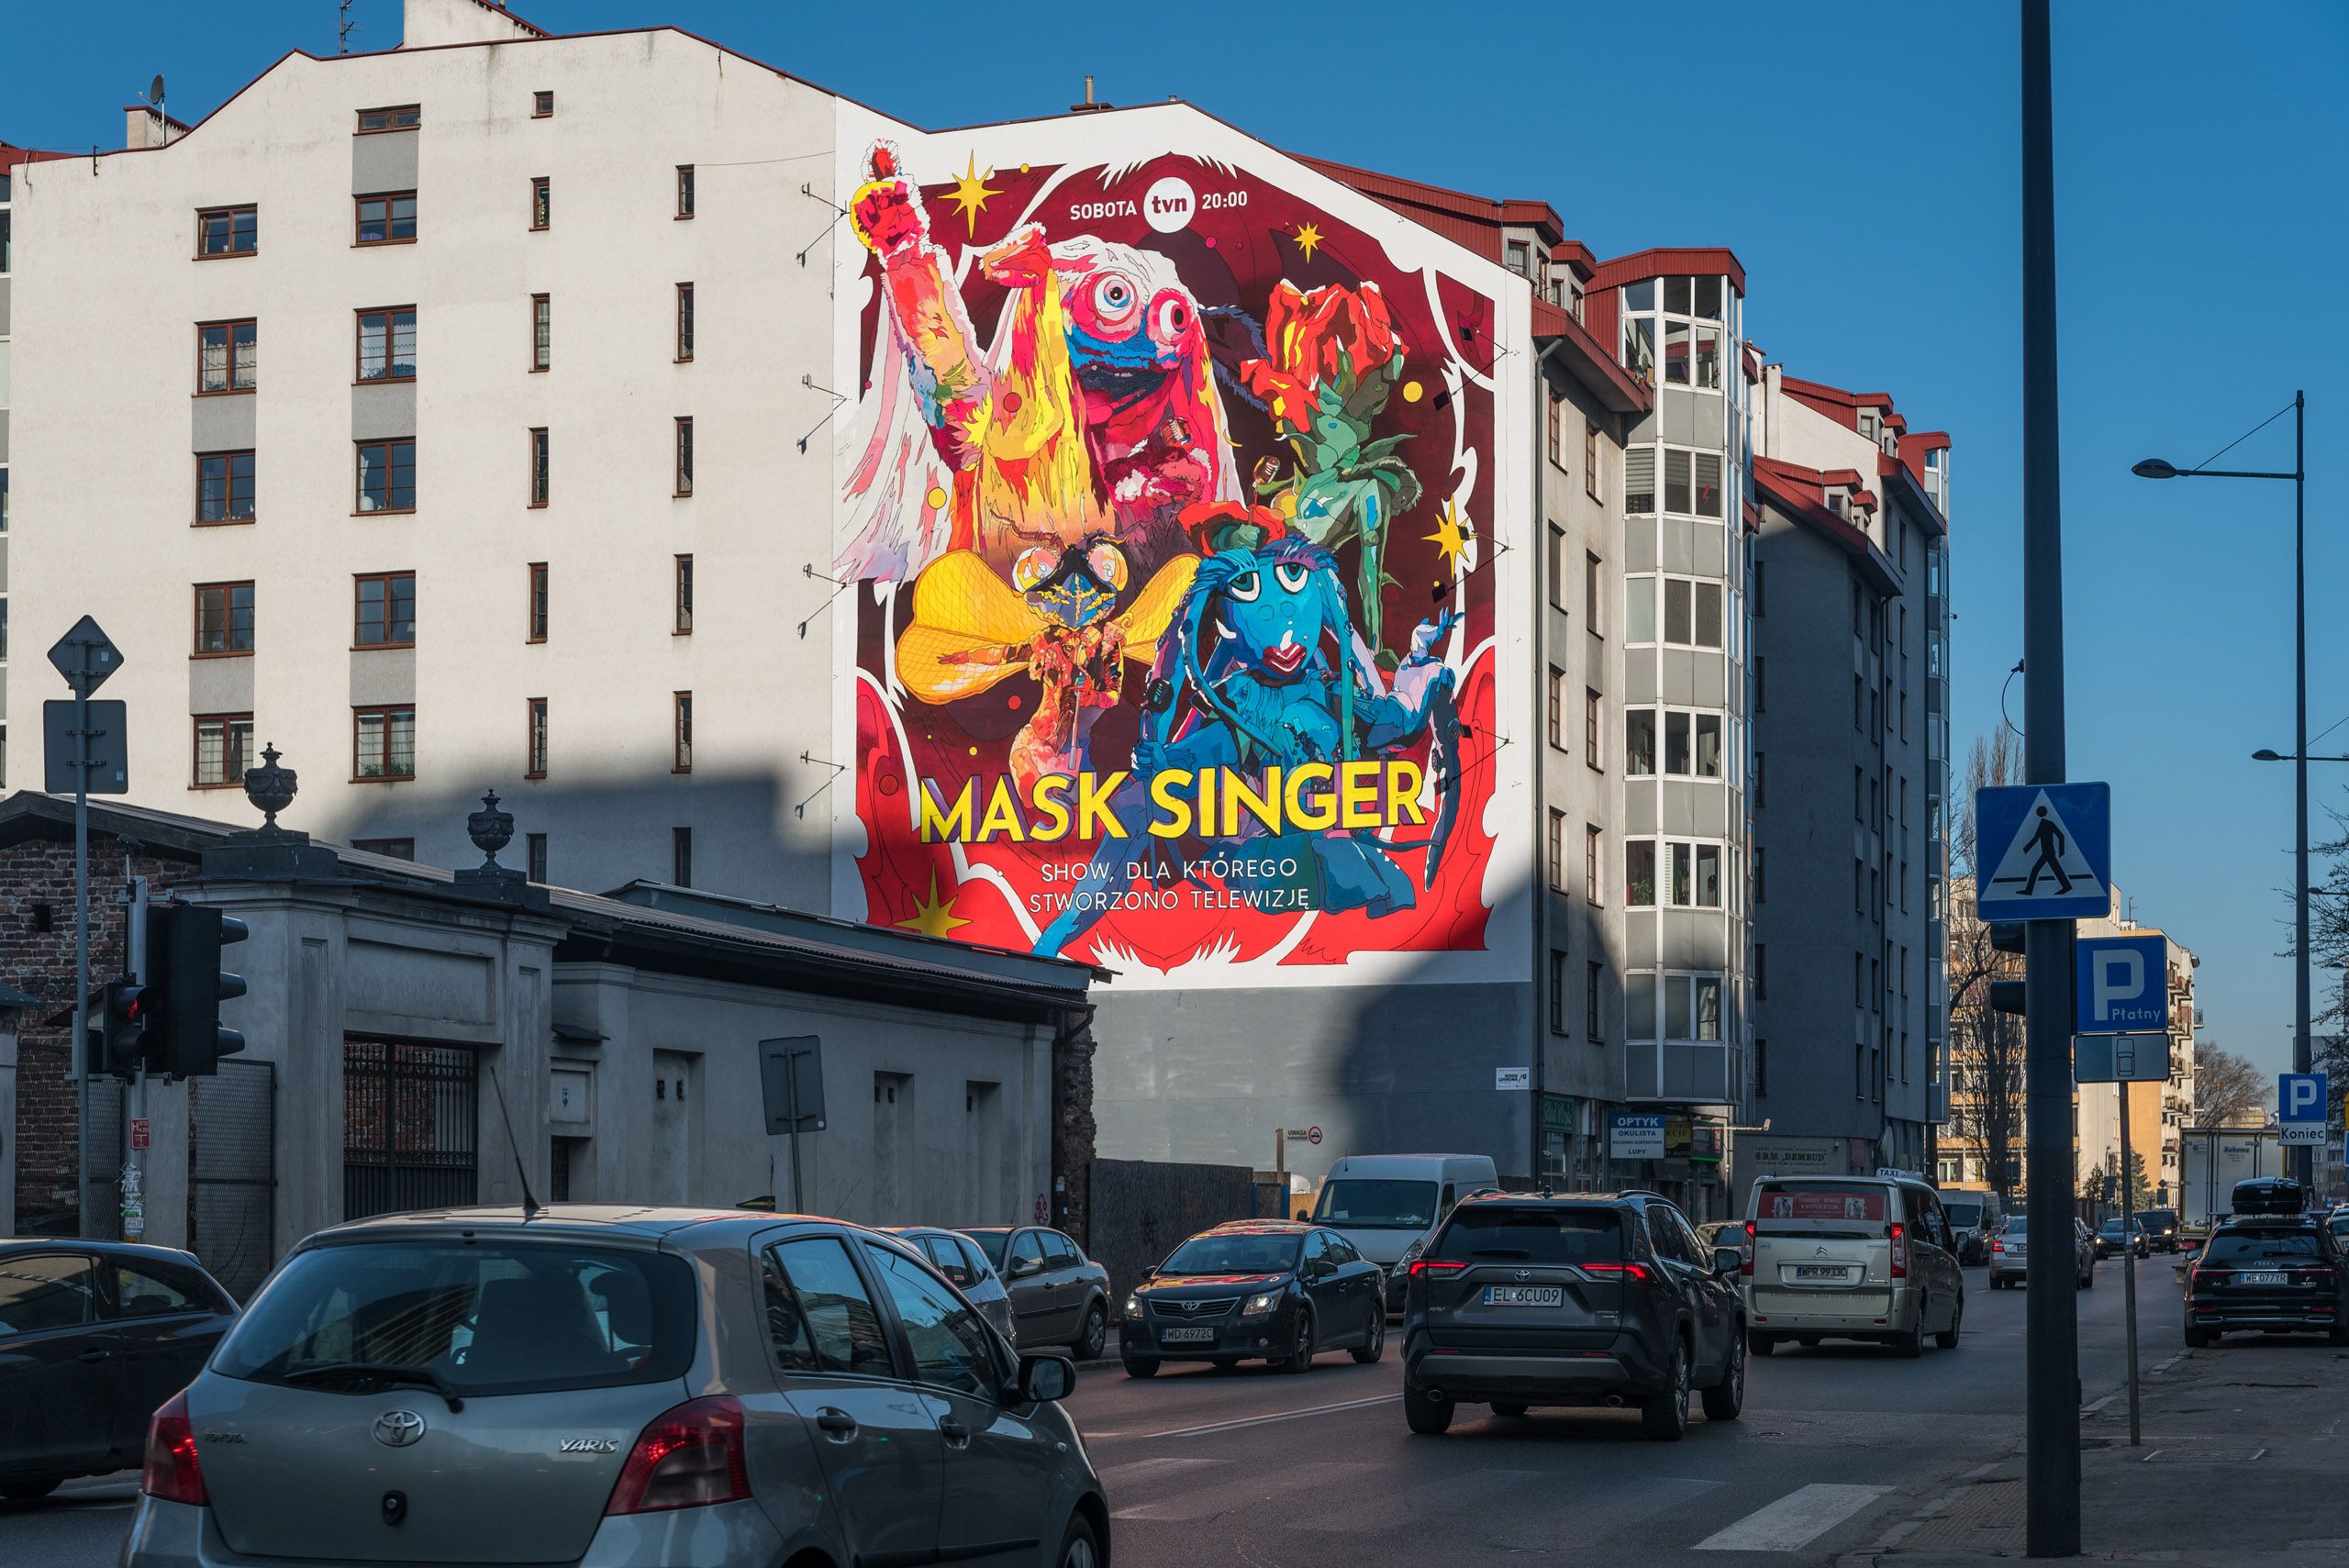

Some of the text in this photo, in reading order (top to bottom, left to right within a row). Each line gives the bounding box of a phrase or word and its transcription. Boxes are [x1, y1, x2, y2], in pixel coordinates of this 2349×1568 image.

[1070, 191, 1248, 220] SOBOTA tvn 20:00
[920, 760, 1427, 843] MASK SINGER
[1041, 851, 1297, 883] SHOW, DLA KTÓREGO
[1029, 887, 1310, 913] STWORZONO TELEWIZJĘ
[2092, 949, 2144, 1021] P
[2112, 1007, 2161, 1023] Płatny
[2289, 1078, 2318, 1117] P
[1617, 1117, 1659, 1128] OPTYK
[2281, 1127, 2325, 1140] Koniec
[1879, 1169, 1898, 1177] TAXI
[1802, 1267, 1819, 1276] WPR
[2245, 1273, 2287, 1283] WE 077YR
[1493, 1287, 1559, 1303] EL 6CU09
[1167, 1329, 1213, 1340] WD 6972C
